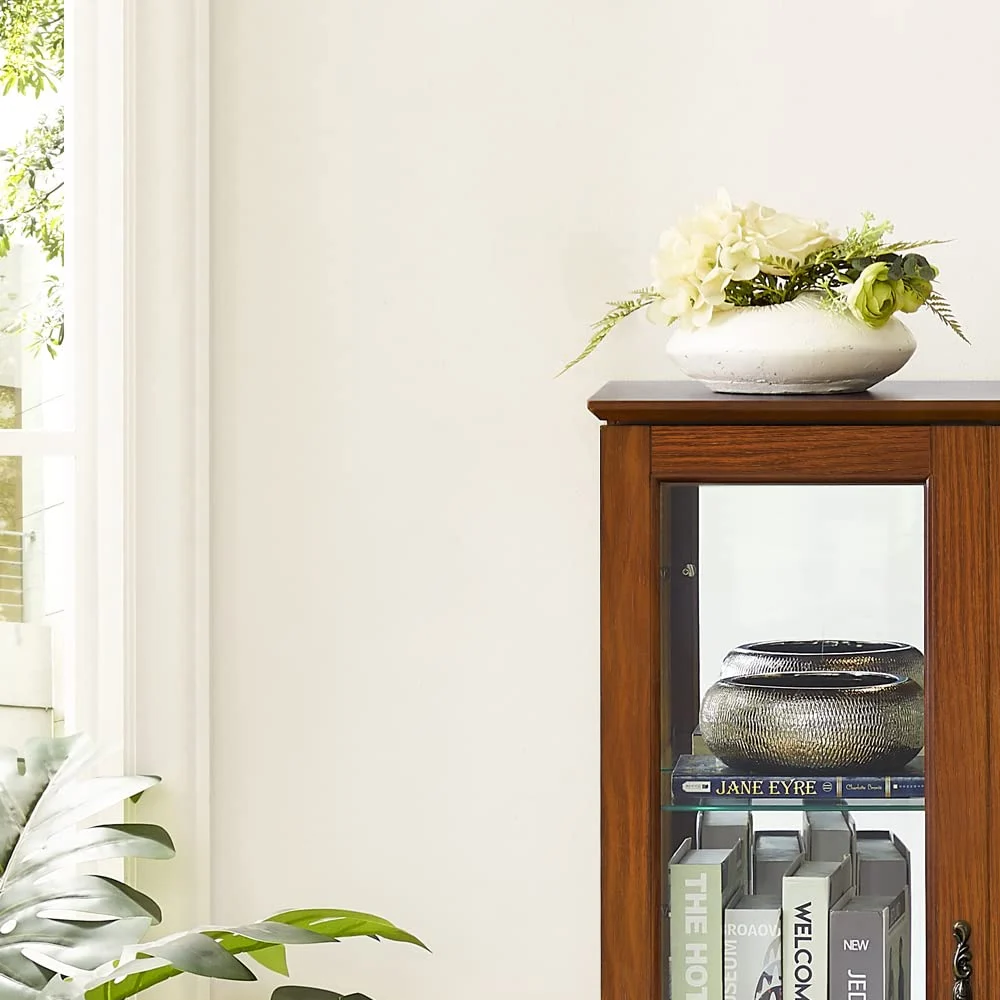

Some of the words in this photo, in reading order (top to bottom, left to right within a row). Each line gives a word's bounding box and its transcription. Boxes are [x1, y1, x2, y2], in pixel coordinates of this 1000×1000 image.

[716, 780, 764, 795] JANE
[768, 778, 817, 796] EYRE
[685, 872, 708, 934] THE
[843, 939, 869, 951] NEW
